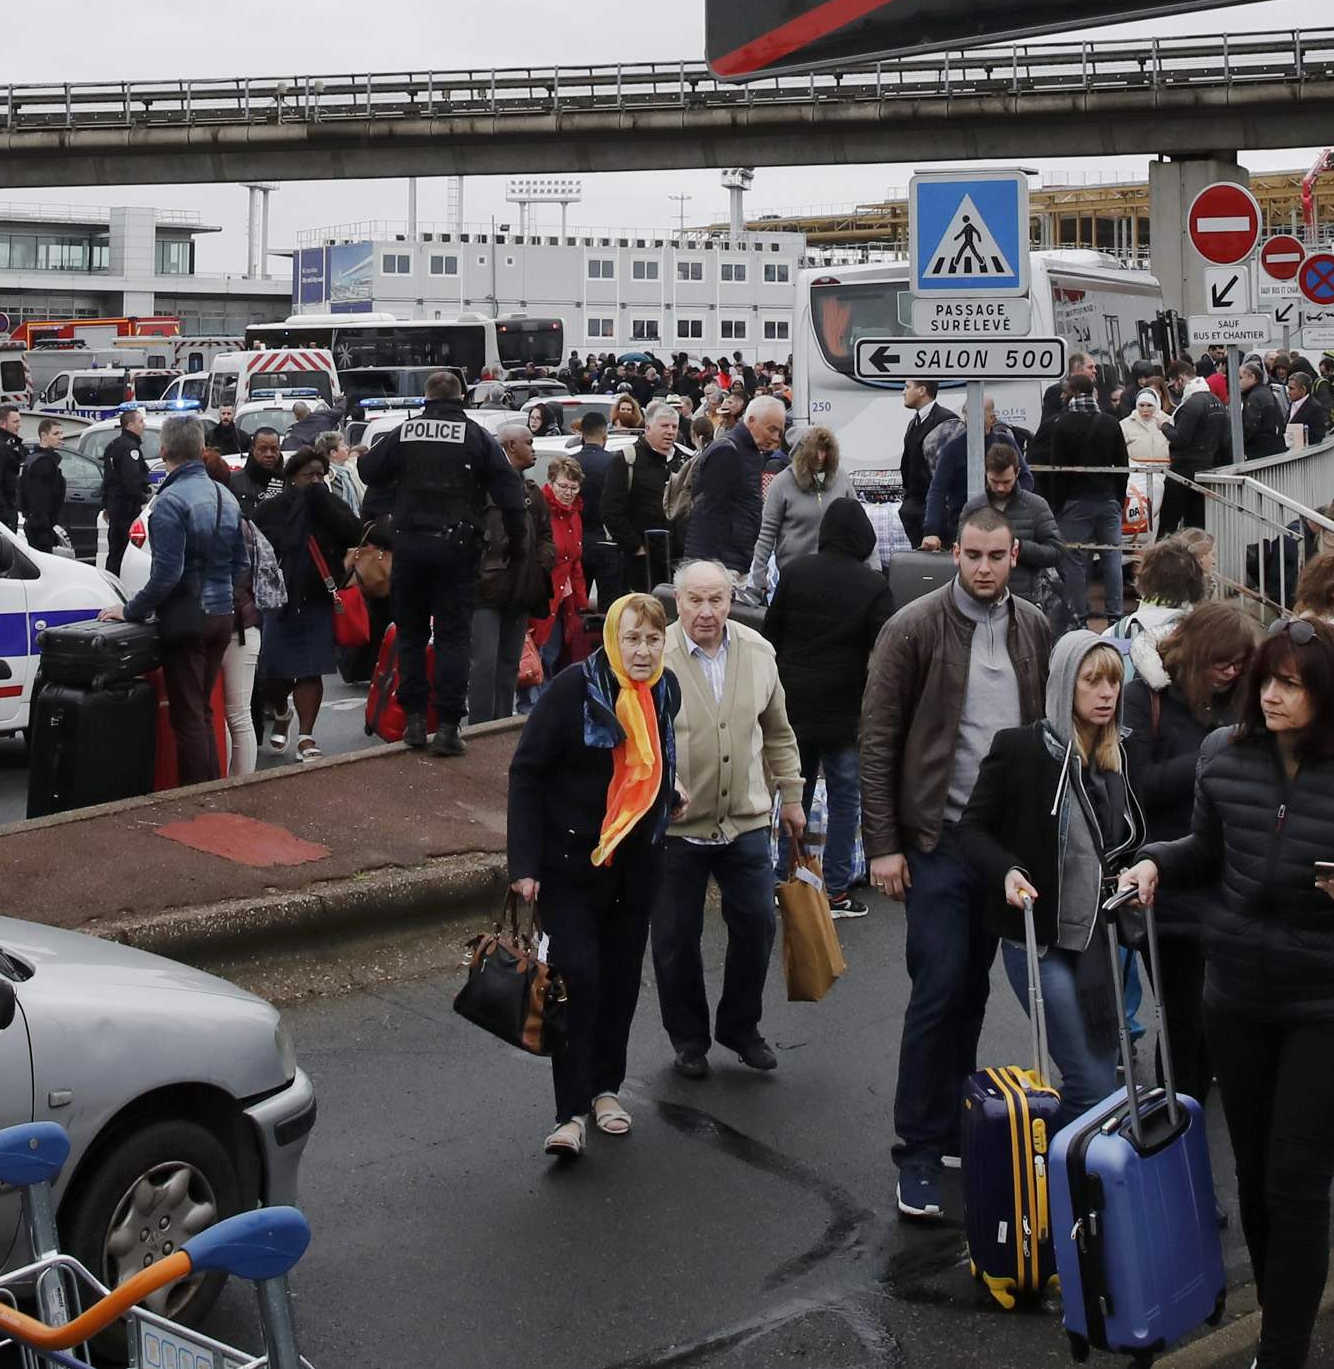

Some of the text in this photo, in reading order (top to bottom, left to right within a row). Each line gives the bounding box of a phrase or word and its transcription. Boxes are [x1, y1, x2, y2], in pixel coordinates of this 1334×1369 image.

[936, 304, 1006, 316] PASSAGE
[931, 317, 1011, 332] SURÉLEVÉ
[1218, 320, 1240, 329] SAUF
[1193, 331, 1265, 340] BUS ET CHANTIER
[914, 350, 1053, 369] SALON 500
[813, 402, 832, 412] 250
[404, 423, 461, 439] POLICE
